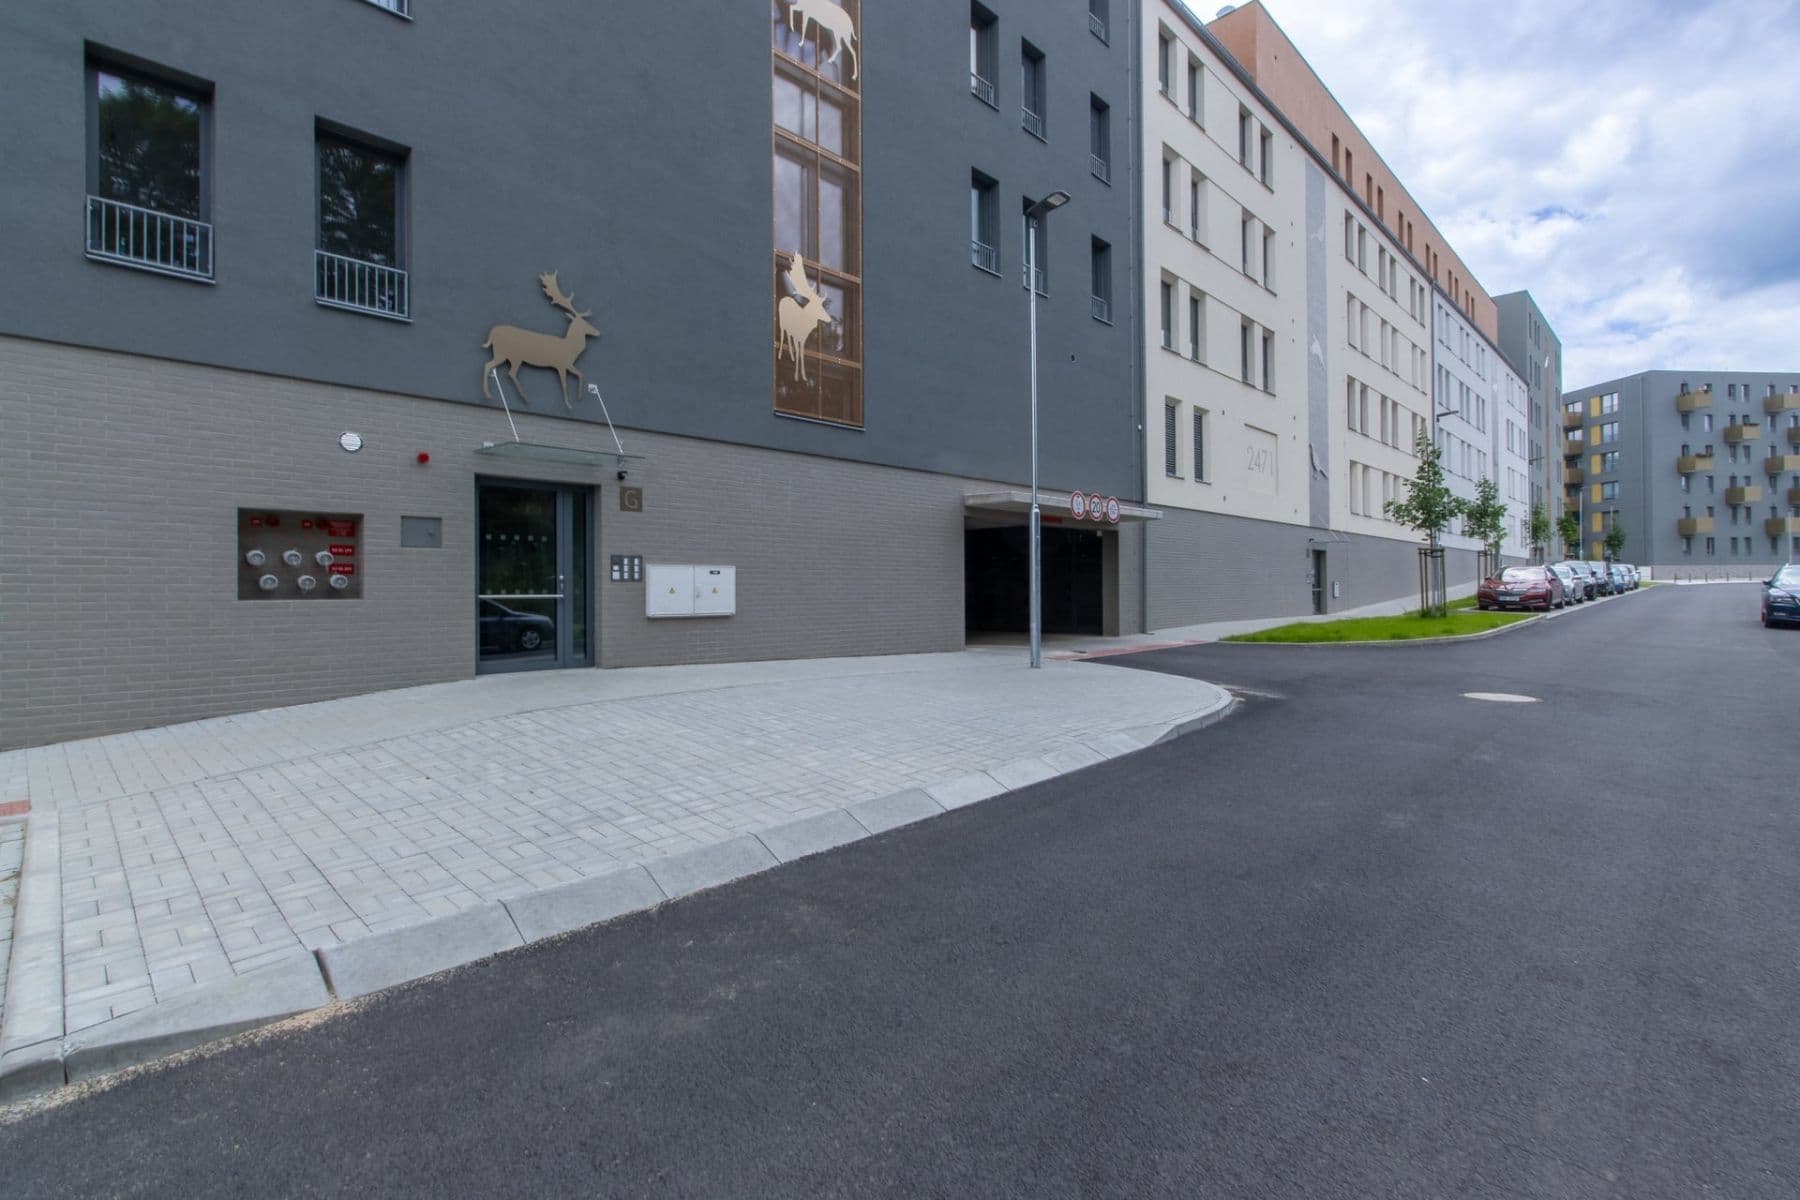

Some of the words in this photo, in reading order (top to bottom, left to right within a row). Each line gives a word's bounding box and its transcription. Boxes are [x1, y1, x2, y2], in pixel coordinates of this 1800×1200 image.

[1247, 446, 1273, 476] 2471
[624, 490, 638, 509] G
[1092, 501, 1100, 513] 20
